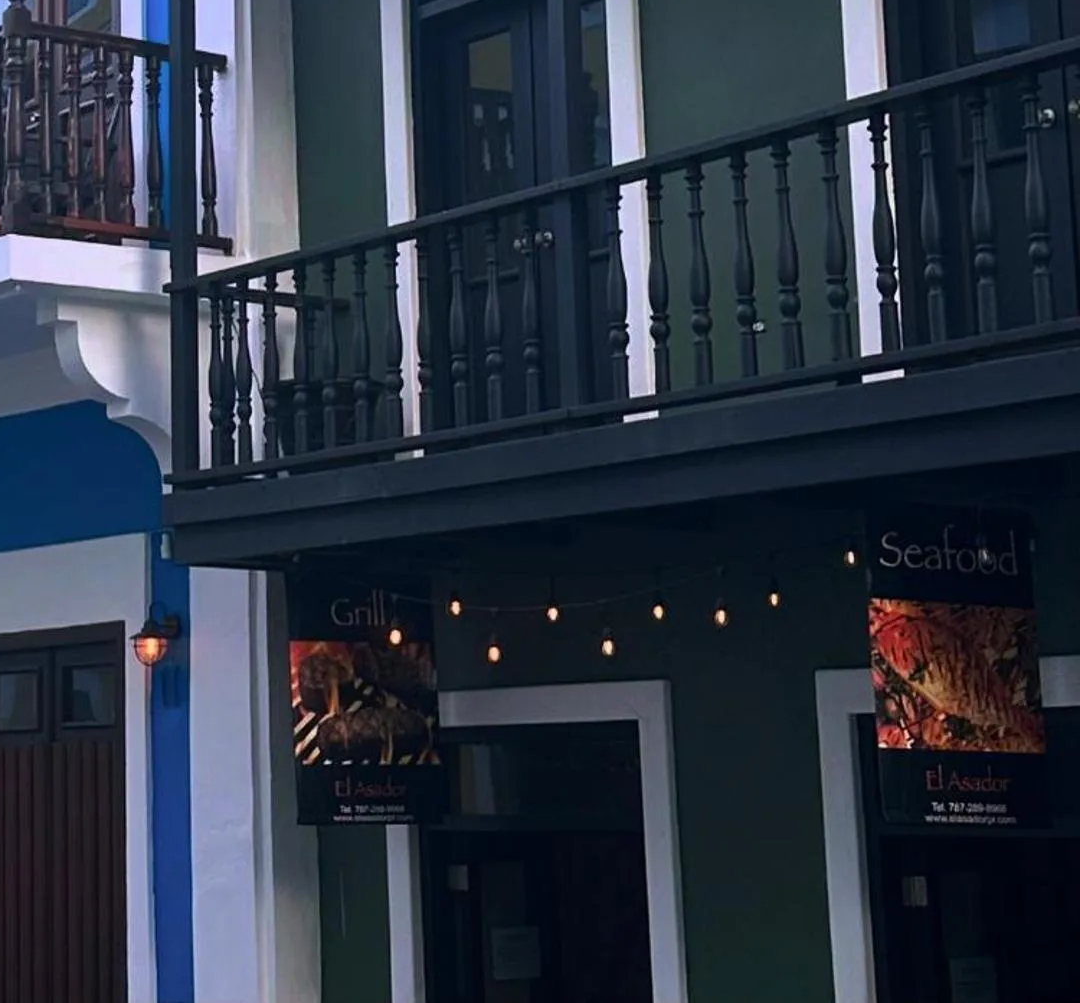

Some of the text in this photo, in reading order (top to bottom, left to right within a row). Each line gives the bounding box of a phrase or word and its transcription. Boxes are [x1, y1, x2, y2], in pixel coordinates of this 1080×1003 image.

[879, 523, 1018, 576] Seafood
[330, 588, 386, 627] Grill
[335, 775, 351, 797] El
[926, 762, 1012, 792] El Asador
